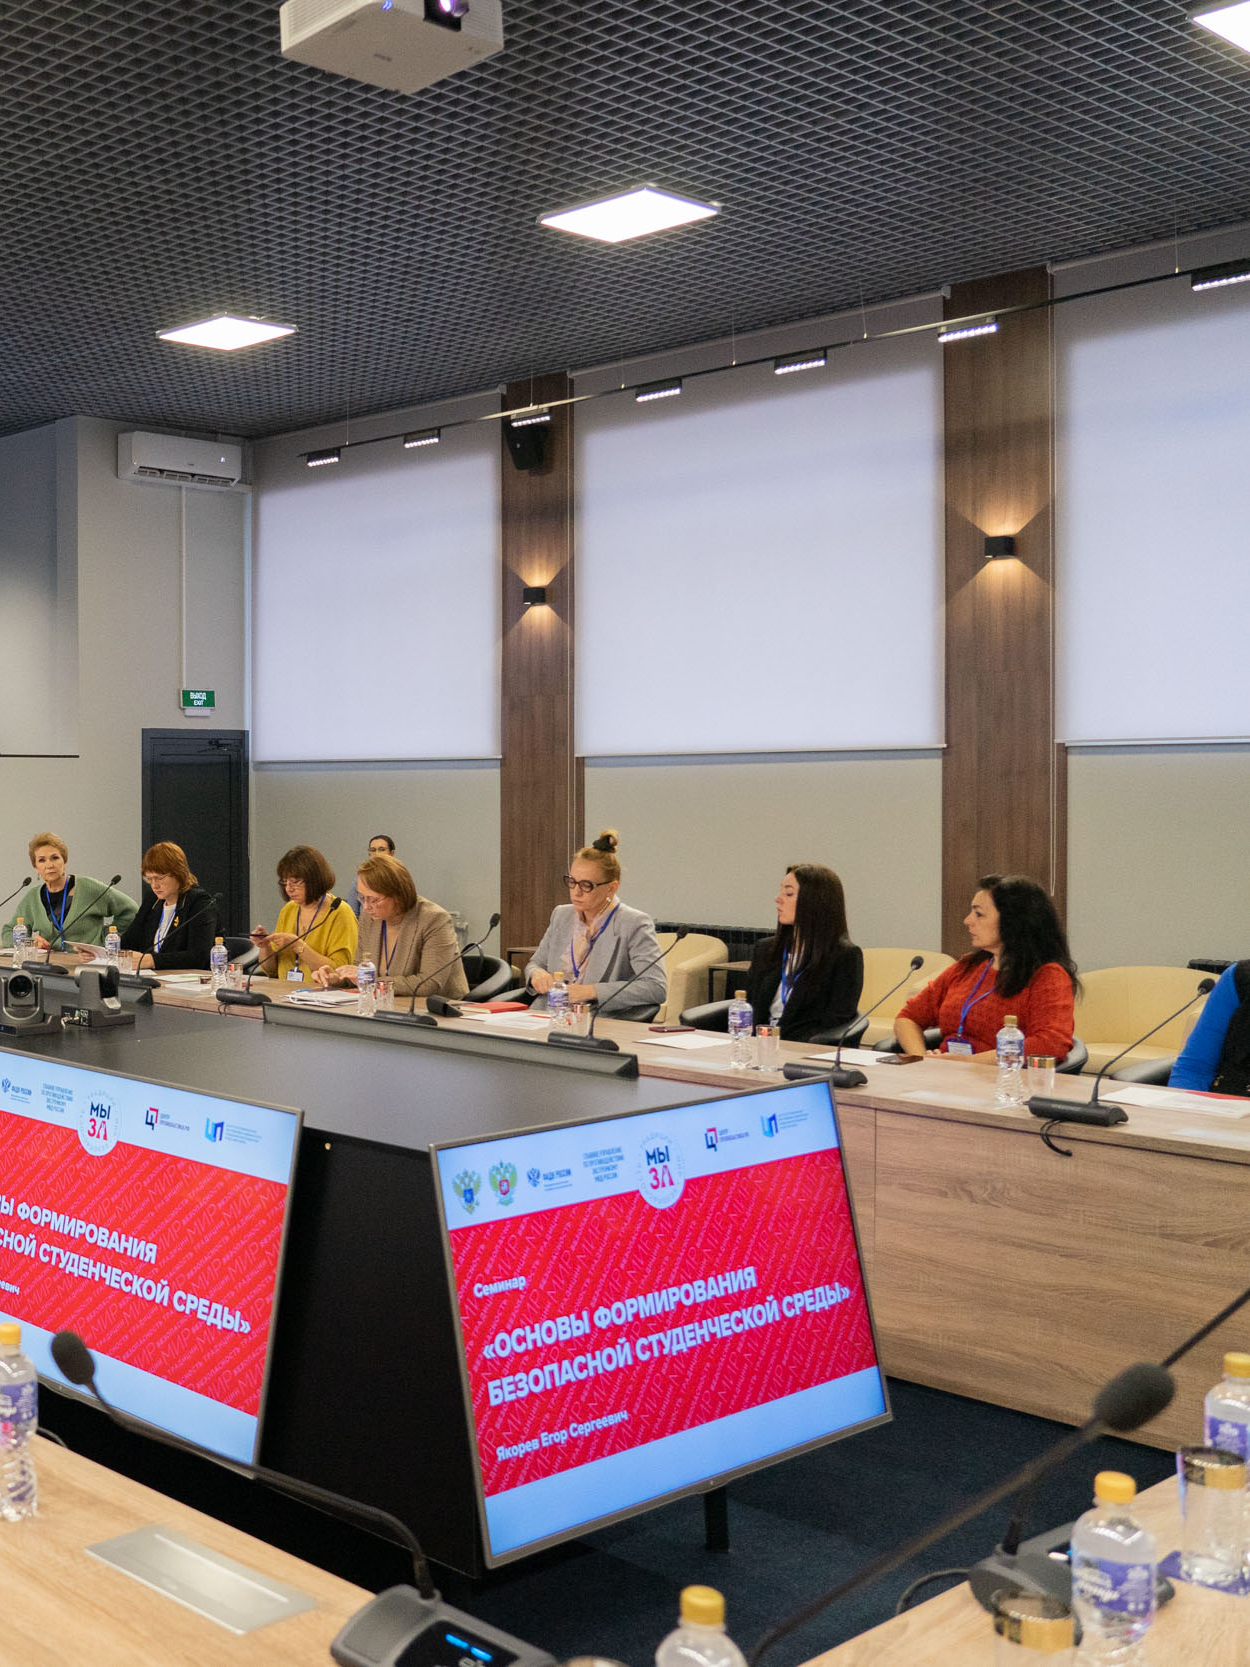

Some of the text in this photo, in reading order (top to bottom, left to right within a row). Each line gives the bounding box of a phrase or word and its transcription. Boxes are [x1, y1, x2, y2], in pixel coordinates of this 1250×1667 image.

[89, 1101, 110, 1120] МЫ
[645, 1144, 670, 1166] МЫ
[15, 1201, 158, 1263] ФОРМИРОВАНИЯ
[37, 1239, 171, 1307] СТУДЕНЧЕСКОЙ
[171, 1290, 253, 1337] СРЕДЫ»
[473, 1273, 527, 1299] Семинар
[481, 1267, 757, 1361] «ОСНОВЫ ФОРМИРОВАНИЯ
[486, 1281, 852, 1405] БЕЗОПАСНОЙ СТУДЕНЧЕСКОЙ СРЕДЫ»
[495, 1408, 629, 1464] Якорев Егор Сергеевич
